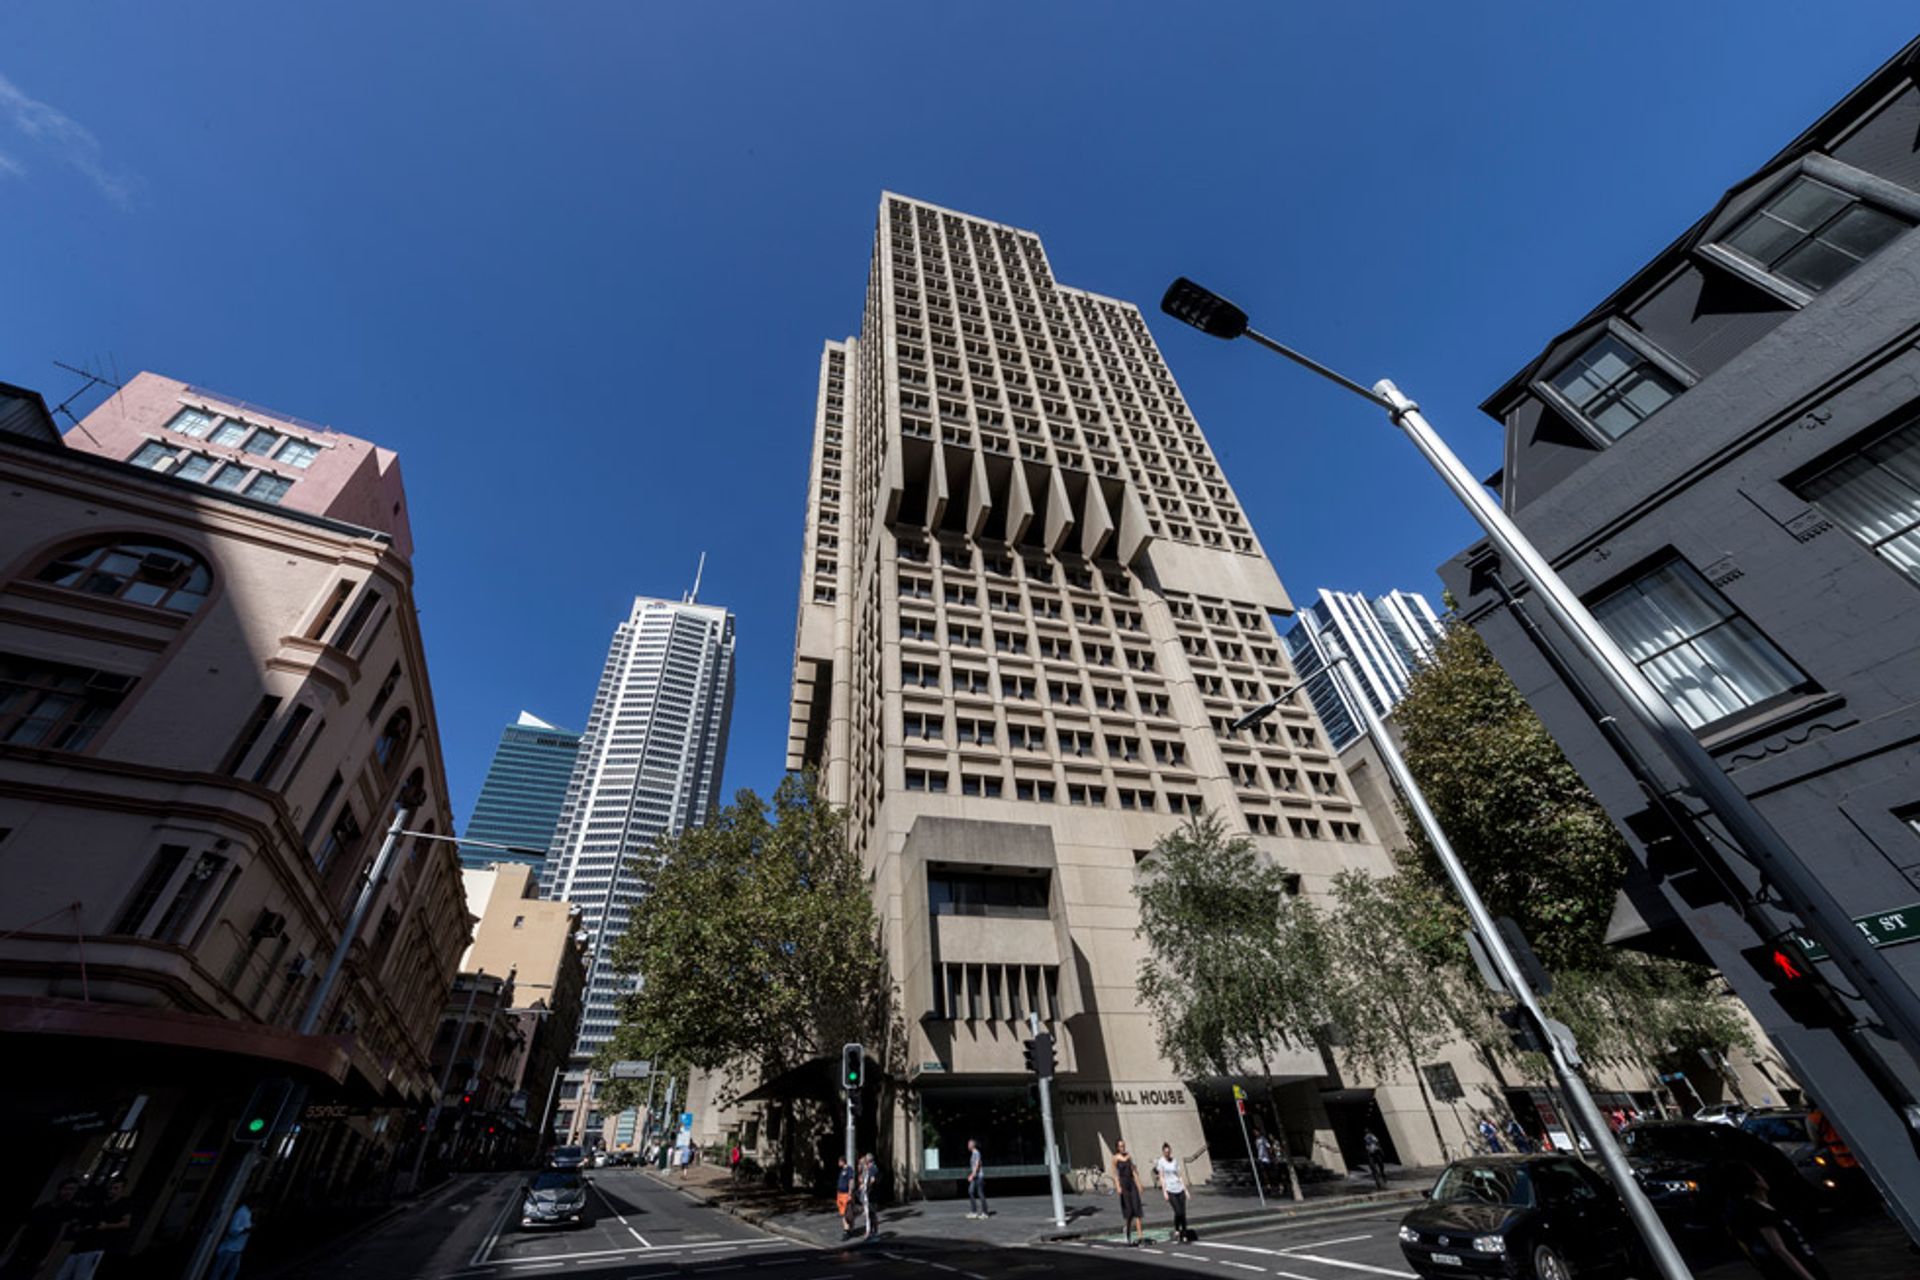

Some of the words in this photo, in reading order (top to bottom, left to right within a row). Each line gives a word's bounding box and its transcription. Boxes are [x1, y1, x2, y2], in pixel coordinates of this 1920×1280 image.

[1878, 913, 1908, 931] ST
[1103, 1090, 1138, 1105] HALL
[1140, 1089, 1186, 1105] HOUSE
